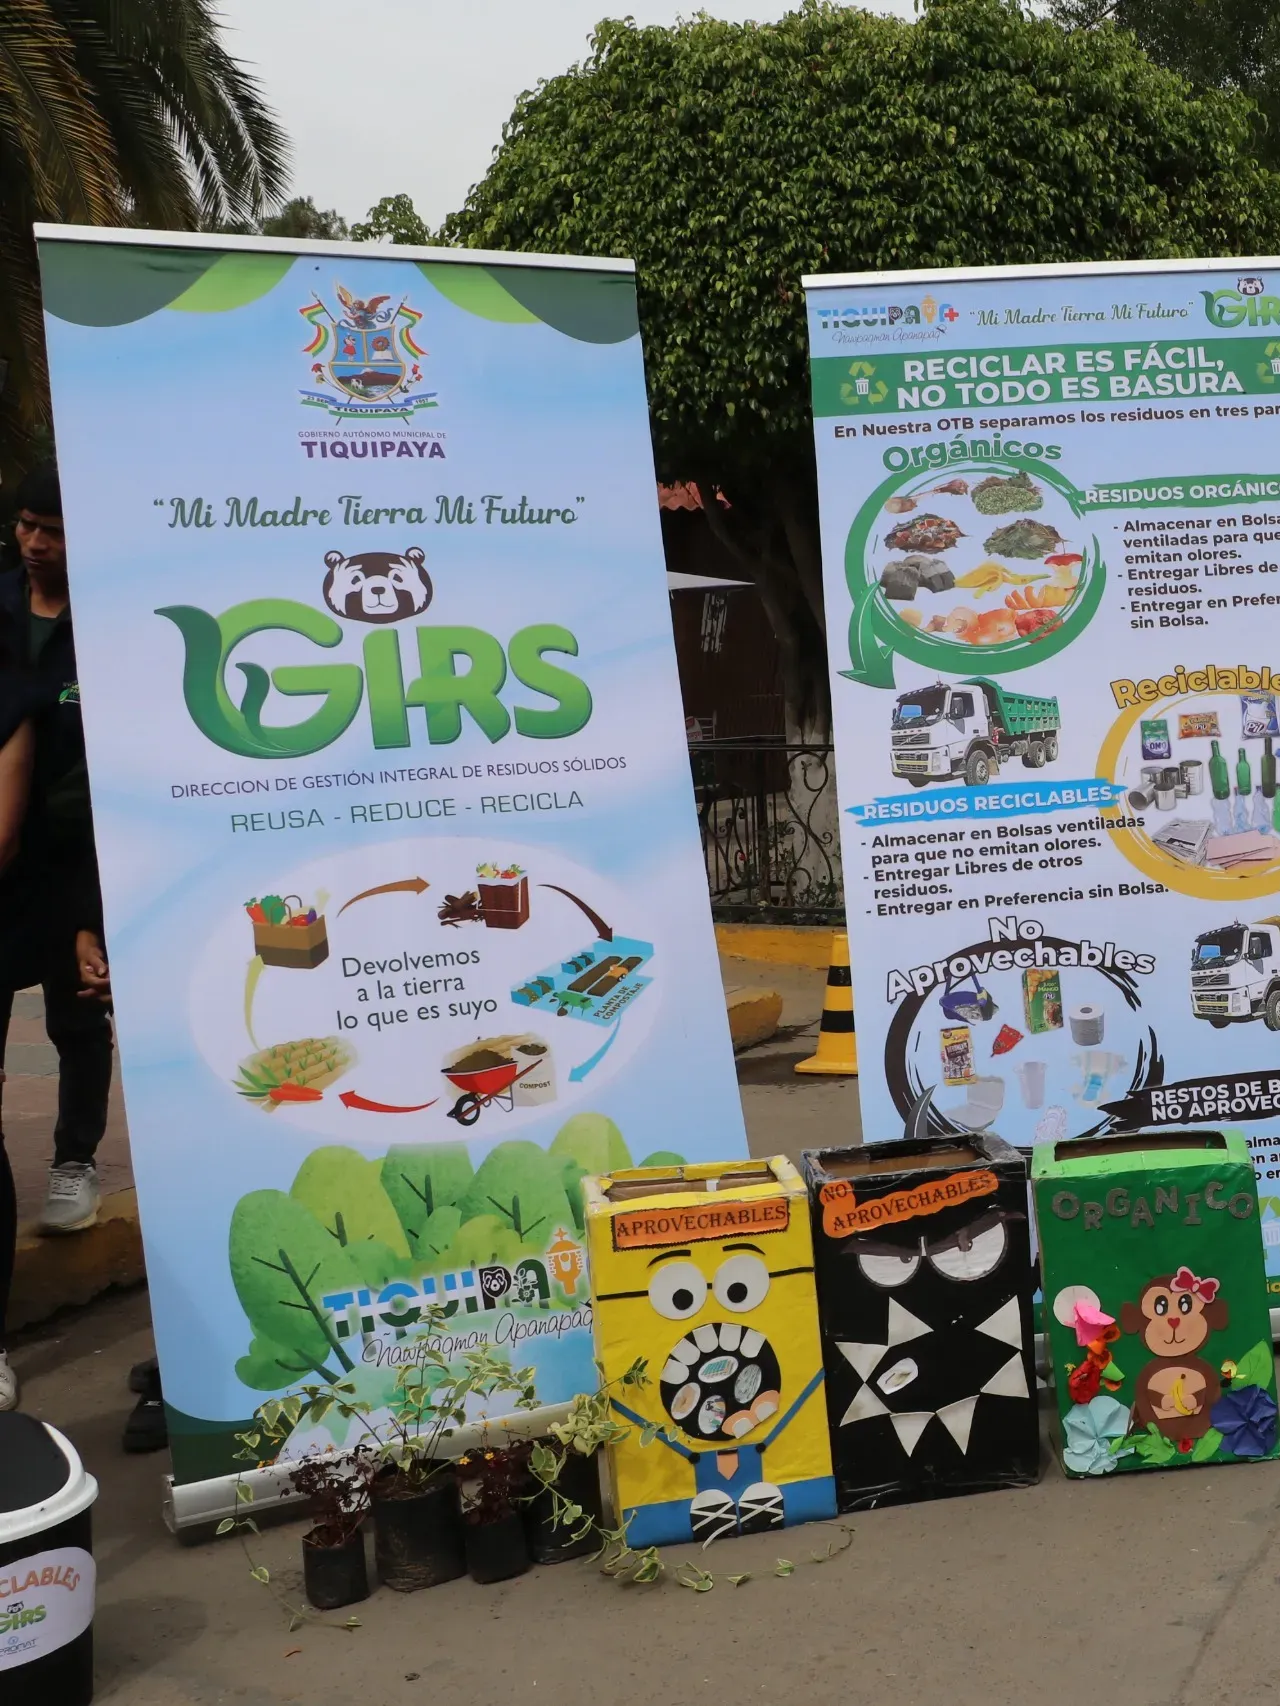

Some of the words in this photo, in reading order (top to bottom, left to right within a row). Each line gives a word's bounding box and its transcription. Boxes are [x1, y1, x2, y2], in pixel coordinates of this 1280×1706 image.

[1004, 308, 1057, 325] Madre
[1061, 305, 1106, 323] Tierra
[1111, 304, 1132, 320] Mi
[904, 352, 1067, 383] RECICLAR
[1076, 350, 1114, 374] ES
[1124, 343, 1225, 373] FÁCIL,
[897, 384, 946, 409] NO
[955, 379, 1051, 405] TODO
[1061, 376, 1100, 400] ES
[1109, 370, 1245, 399] BASURA
[342, 430, 391, 438] AUTÓNOMO
[393, 431, 435, 439] MUNICIPAL
[834, 425, 857, 438] En
[862, 421, 932, 437] Nuestra
[937, 417, 974, 431] OTB
[979, 413, 1076, 430] separamos
[1080, 409, 1105, 423] los
[1110, 407, 1184, 422] residuos
[1189, 406, 1211, 419] en
[1215, 404, 1249, 417] tres
[301, 441, 447, 459] TIQUIPAYA
[882, 433, 1062, 473] Orgánicos
[1085, 486, 1185, 504] RESIDUOS
[224, 496, 332, 528] Madre
[338, 495, 427, 526] Tierra
[435, 495, 477, 524] Mi
[1123, 518, 1212, 533] Almacenar
[1217, 516, 1237, 528] en
[1123, 533, 1208, 548] ventiladas
[1213, 532, 1249, 546] para
[1125, 551, 1183, 564] emitan
[1188, 548, 1242, 562] olores.
[1128, 566, 1199, 581] Entregar
[1204, 563, 1254, 577] Libres
[1258, 561, 1279, 573] de
[1127, 583, 1202, 597] residuos.
[1131, 599, 1203, 615] Entregar
[1207, 597, 1228, 609] en
[1130, 616, 1154, 629] sin
[1159, 614, 1209, 628] Bolsa.
[154, 597, 593, 759] GIRS
[171, 779, 270, 798] DIRECCION
[275, 777, 298, 791] DE
[302, 770, 374, 789] GESTIÓN
[380, 766, 459, 784] INTEGRAL
[462, 765, 483, 778] DE
[487, 760, 559, 777] RESIDUOS
[563, 756, 627, 772] SÓLIDOS
[231, 808, 325, 833] REUSA
[351, 798, 457, 823] REDUCE
[481, 790, 584, 814] RECICLA
[863, 798, 969, 819] RESIDUOS
[974, 785, 1112, 811] RECICLABLES
[872, 831, 965, 848] Almacenar
[970, 829, 992, 840] en
[997, 824, 1052, 839] Bolsas
[1056, 815, 1146, 834] ventiladas
[871, 852, 909, 868] para
[914, 849, 947, 864] que
[952, 847, 974, 859] no
[979, 841, 1039, 856] emitan
[1044, 837, 1102, 852] olores.
[874, 866, 950, 882] Entregar
[955, 861, 1008, 875] Libres
[1012, 858, 1034, 871] de
[1038, 855, 1083, 870] otros
[874, 883, 953, 899] residuos.
[877, 900, 953, 917] Entregar
[957, 898, 979, 909] en
[984, 887, 1084, 907] Preferencia
[1088, 884, 1114, 899] sin
[1118, 881, 1169, 896] Bolsa.
[988, 916, 1044, 943] No
[341, 950, 481, 978] Devolvemos
[886, 940, 1157, 1002] Aprovechables
[357, 988, 369, 1002] a
[377, 980, 395, 999] la
[403, 977, 465, 996] tierra
[602, 982, 643, 1019] COMPOSTAJE
[337, 1010, 358, 1030] lo
[367, 1009, 409, 1031] que
[417, 1005, 440, 1020] es
[448, 999, 498, 1020] suyo
[593, 994, 620, 1017] PLANTA
[519, 1081, 551, 1089] COMPOST
[1150, 1084, 1229, 1105] RESTOS
[1235, 1080, 1263, 1097] DE
[1152, 1104, 1183, 1121] NO
[824, 1183, 848, 1201] NO
[833, 1173, 991, 1231] APROVECHABLES
[1052, 1181, 1254, 1231] ORGANICO
[617, 1205, 787, 1238] APROVECHABLES
